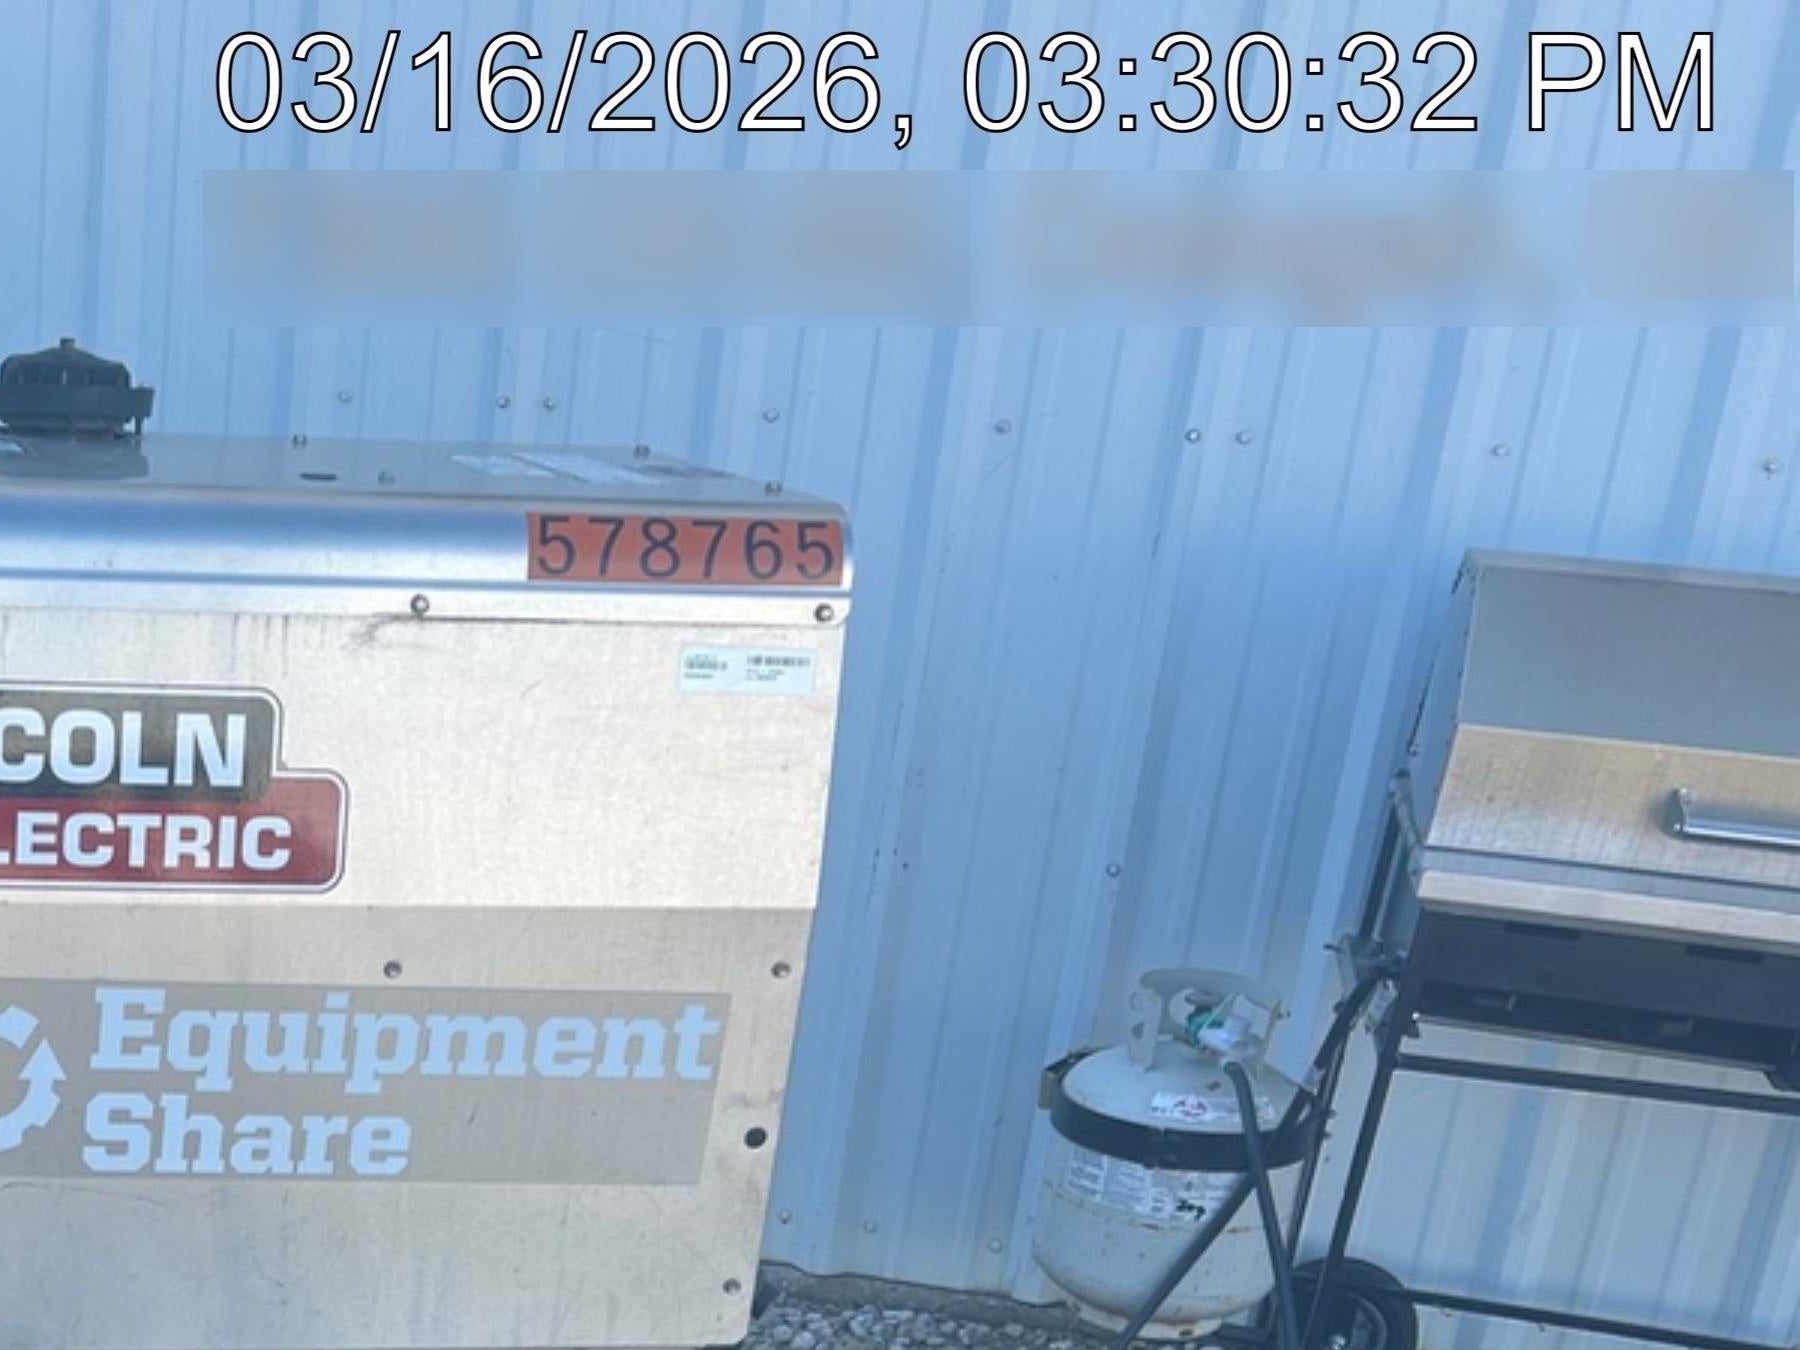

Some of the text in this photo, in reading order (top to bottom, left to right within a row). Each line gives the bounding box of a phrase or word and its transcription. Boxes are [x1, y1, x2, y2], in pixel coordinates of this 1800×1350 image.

[536, 514, 834, 579] 578765
[90, 986, 720, 1095] Equipment
[81, 1091, 411, 1176] Share
